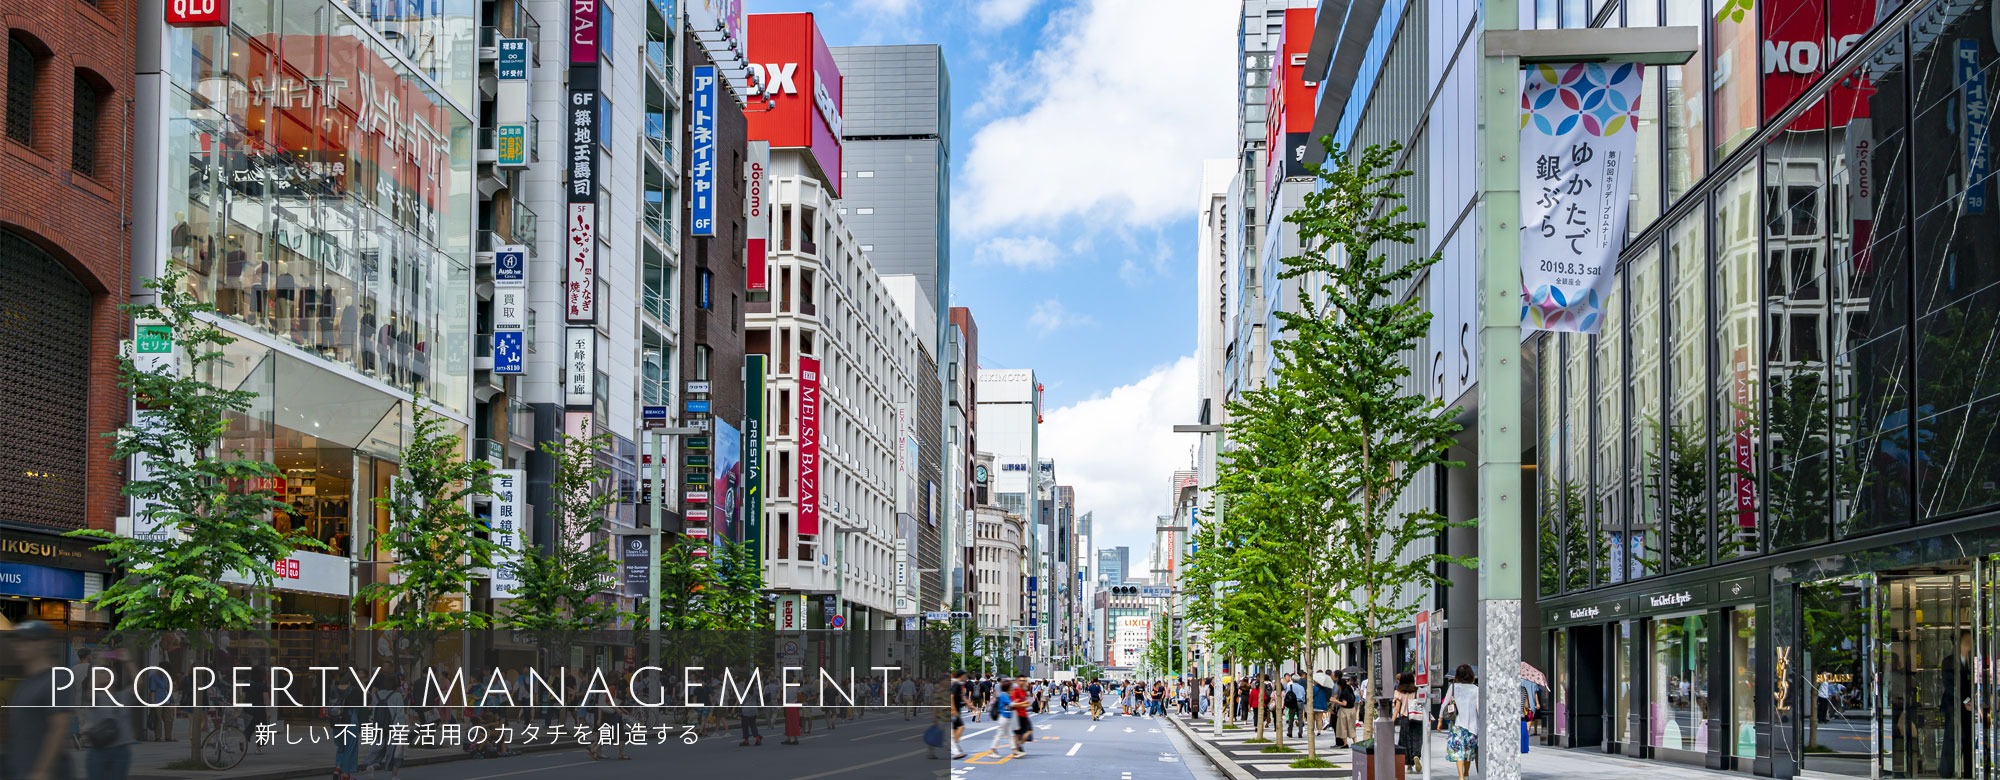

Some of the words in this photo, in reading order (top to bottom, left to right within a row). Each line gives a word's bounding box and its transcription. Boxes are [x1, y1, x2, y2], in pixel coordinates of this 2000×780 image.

[174, 0, 214, 18] QLO
[575, 0, 593, 45] RAJ
[573, 93, 593, 105] 6F
[694, 76, 712, 209] アートネイチャー
[752, 162, 763, 217] docomo
[1536, 154, 1562, 238] 銀ぶら
[1565, 141, 1593, 255] ゆかたで
[695, 219, 710, 229] 6F
[1540, 260, 1584, 275] 2019.8.3
[1587, 266, 1602, 276] sat
[504, 294, 515, 318] 買取
[570, 281, 580, 316] 焼き鳥
[582, 277, 591, 311] うなぎ
[141, 340, 170, 351] セリナ
[802, 386, 814, 448] MELSA
[801, 453, 814, 514] BAZAR
[289, 569, 299, 577] QLO
[1125, 619, 1145, 627] LIXIL
